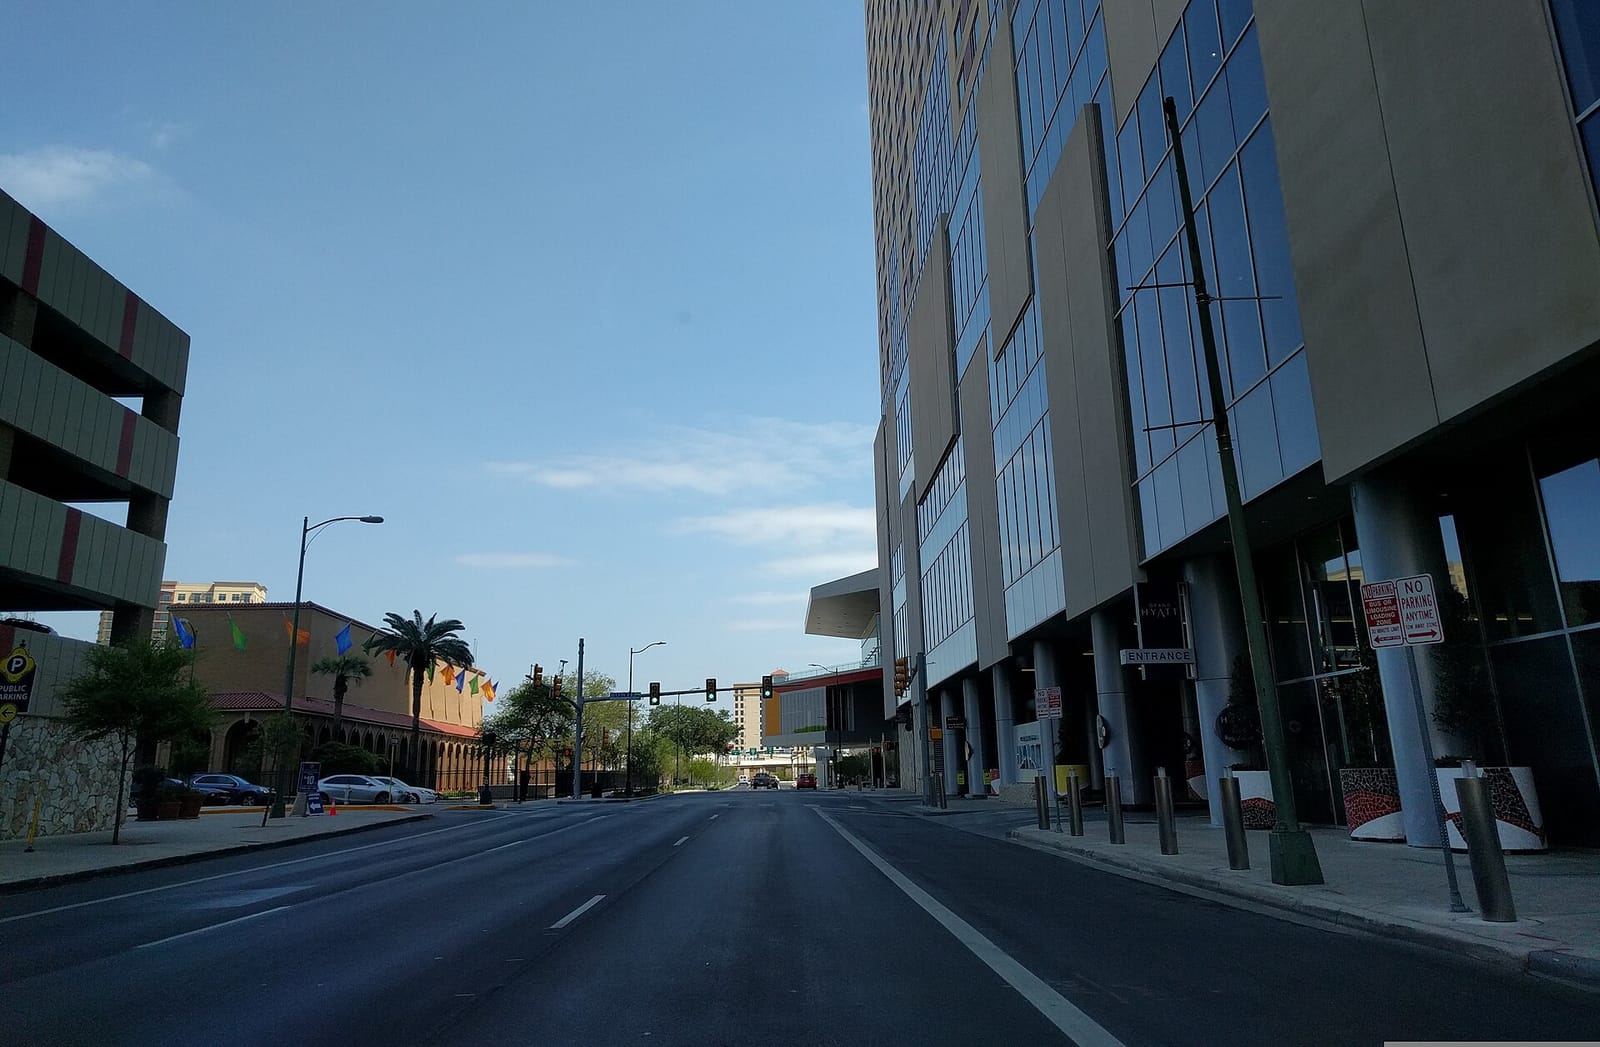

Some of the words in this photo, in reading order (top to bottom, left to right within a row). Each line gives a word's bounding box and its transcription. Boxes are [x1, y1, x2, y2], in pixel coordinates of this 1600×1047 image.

[1405, 581, 1423, 594] NO
[1402, 594, 1432, 609] PARKING
[1141, 608, 1177, 617] HYATT
[1366, 605, 1397, 615] LIMOUSINE
[1406, 609, 1434, 622] ANYTIME
[1370, 612, 1396, 621] LOADING
[1129, 651, 1190, 661] ENTRANCE
[11, 658, 23, 672] P
